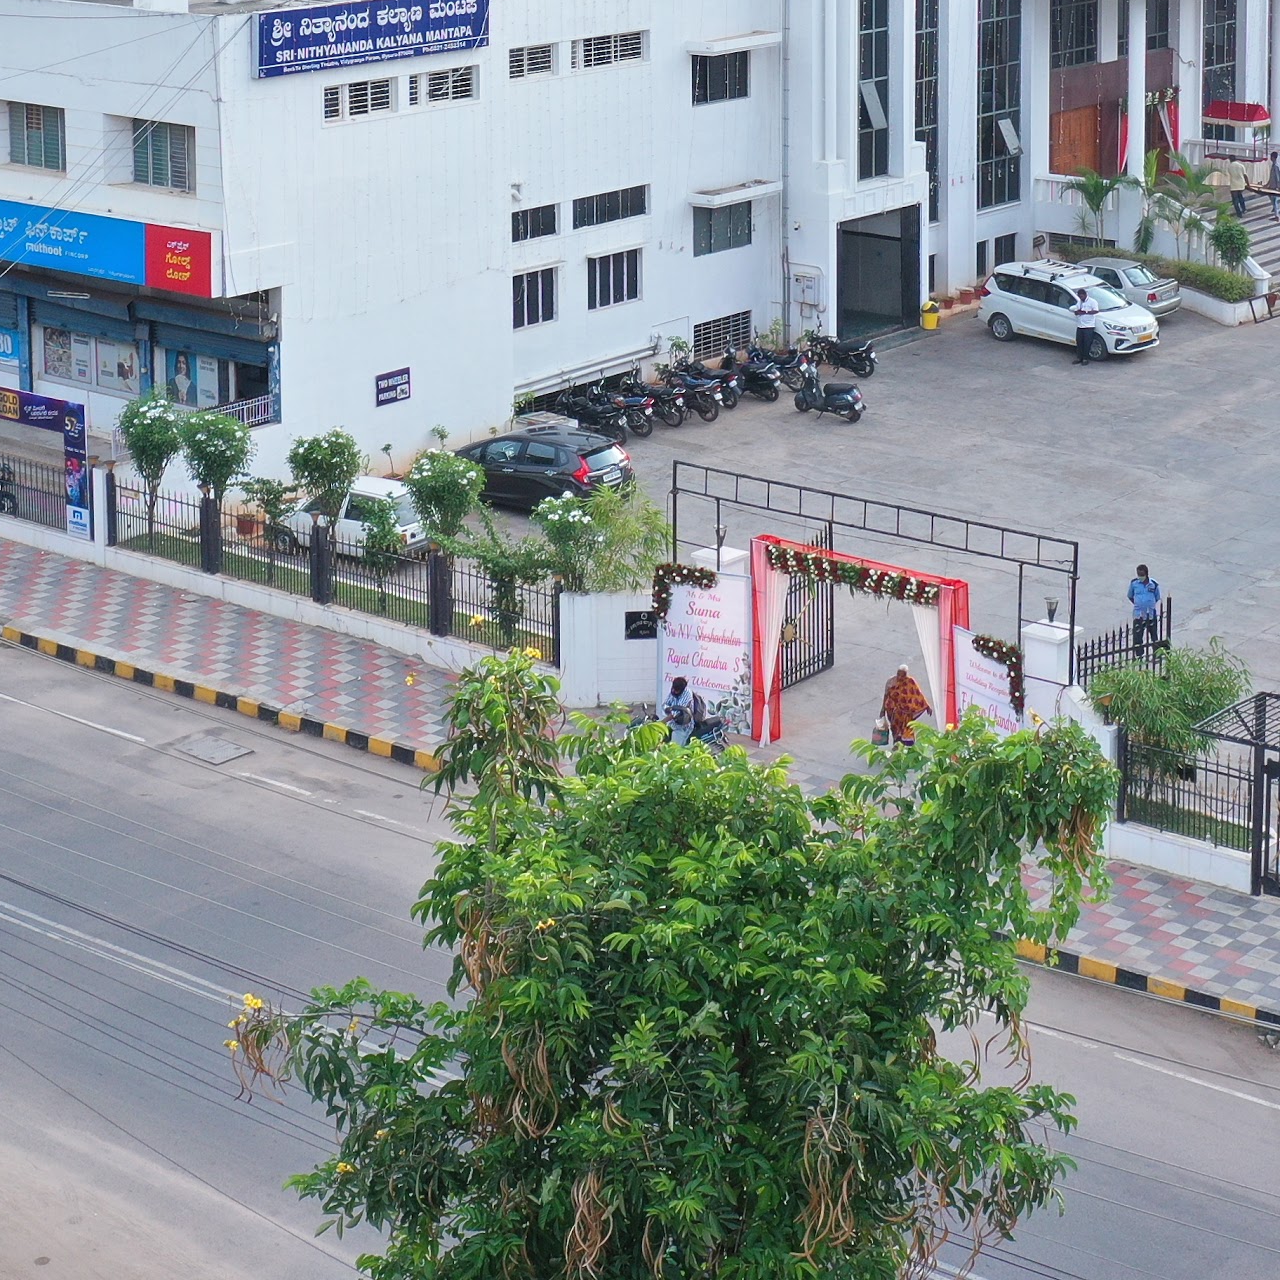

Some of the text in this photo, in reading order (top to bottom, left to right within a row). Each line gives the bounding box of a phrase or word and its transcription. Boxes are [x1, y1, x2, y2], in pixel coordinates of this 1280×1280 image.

[299, 8, 370, 43] ನಿತ್ಯಾನಂದ
[376, 4, 423, 33] ಕಲ್ಯಾಣ
[297, 38, 374, 61] NITHYANANDA
[376, 32, 423, 50] KALYANA
[426, 25, 473, 43] MANTAPA
[25, 241, 63, 257] muthoot
[686, 601, 721, 619] Suma
[691, 651, 728, 671] Chandra
[733, 656, 740, 673] S
[691, 675, 731, 690] Welcomes
